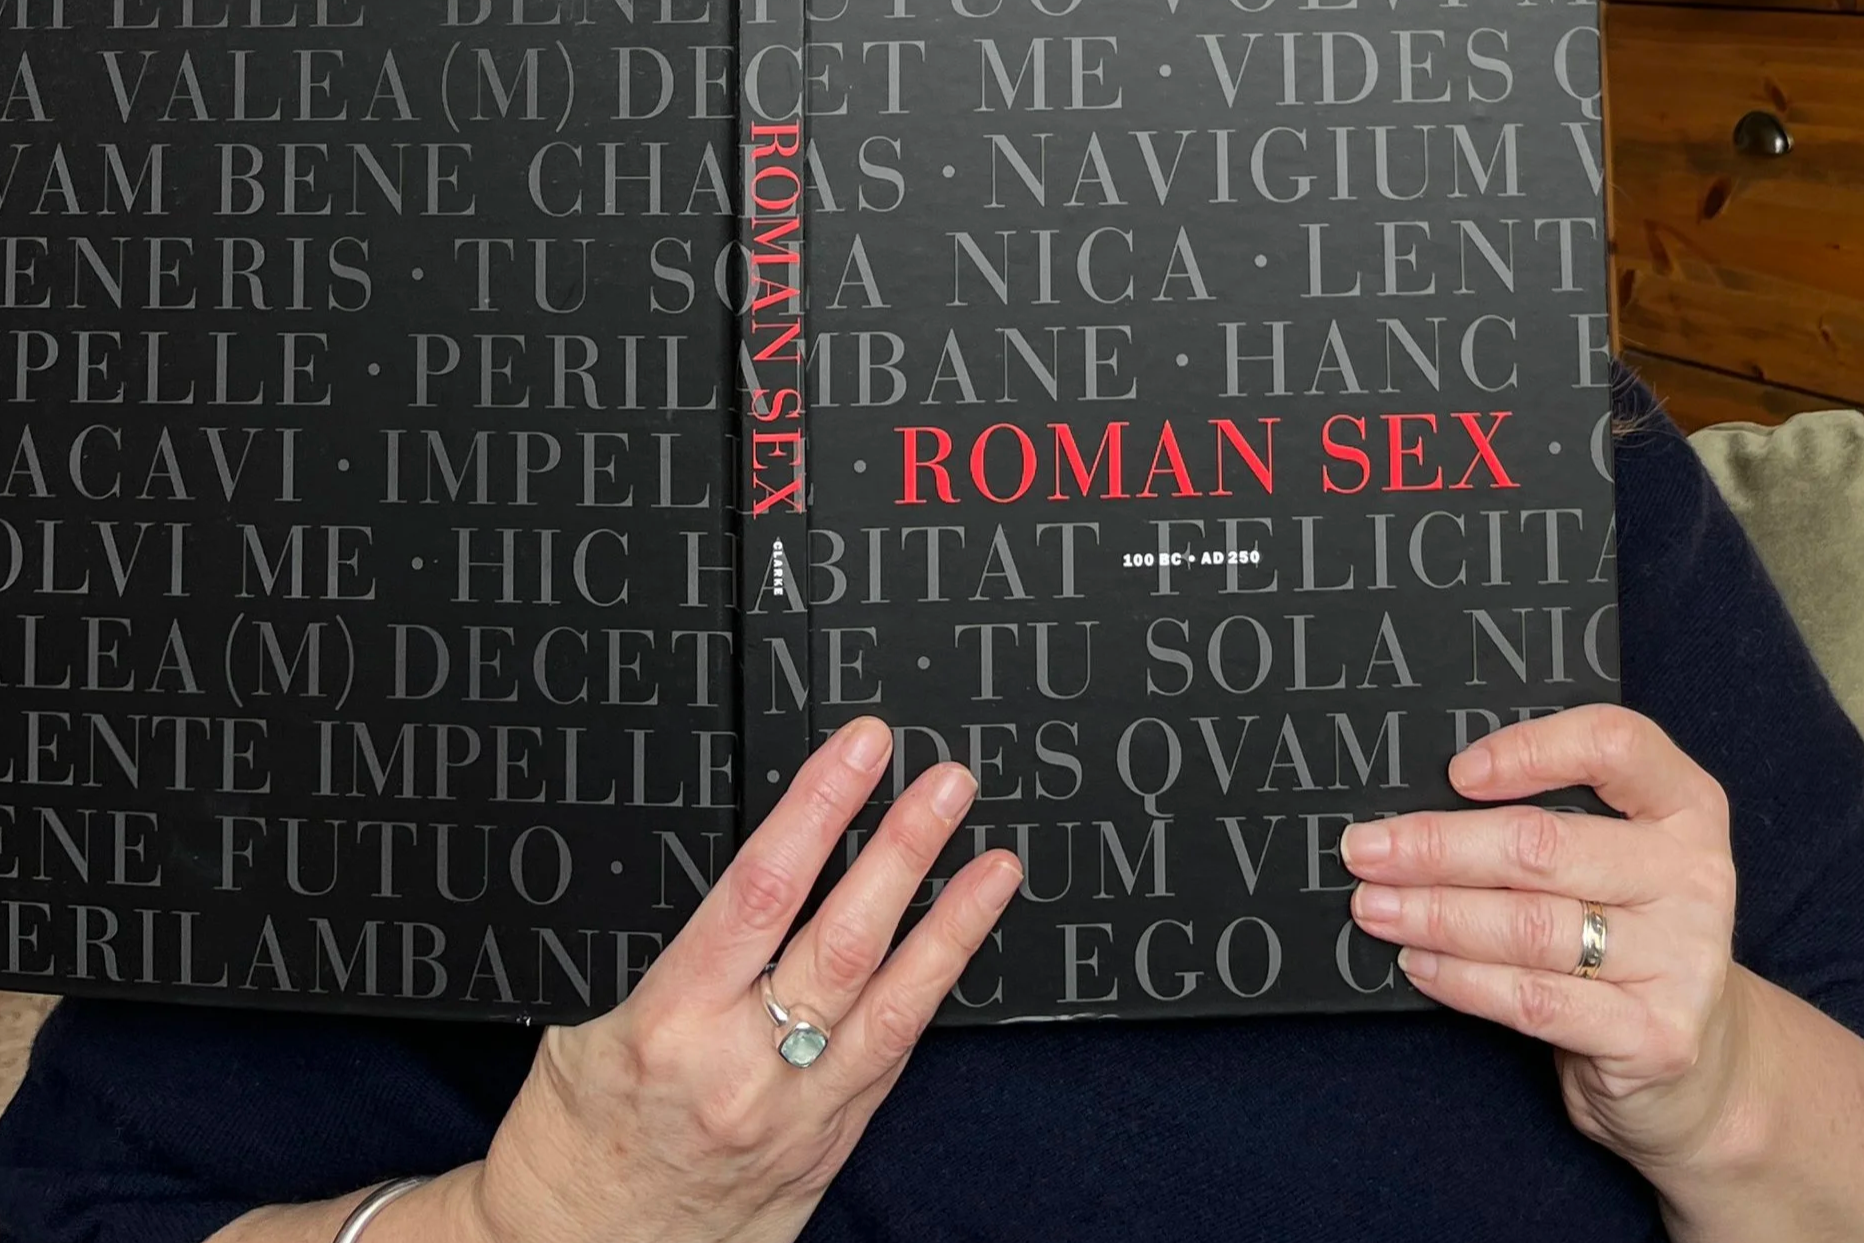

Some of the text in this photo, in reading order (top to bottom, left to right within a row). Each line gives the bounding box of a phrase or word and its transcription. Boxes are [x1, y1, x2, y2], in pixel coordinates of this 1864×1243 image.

[611, 40, 925, 121] DECET
[973, 35, 1123, 115] ME
[1196, 28, 1514, 108] VIDES
[214, 142, 476, 217] BENE
[983, 123, 1527, 209] NAVIGIUM
[0, 236, 373, 312] ENERIS
[455, 238, 596, 313] TU
[946, 226, 1216, 307] NICA
[1301, 217, 1597, 299] LENT
[7, 331, 332, 407] PELLE
[1217, 314, 1519, 398] HANC
[751, 120, 802, 597] ROMAN SEX CLARKE
[0, 424, 303, 503] ACAVI
[894, 417, 1283, 506] ROMAN
[1321, 410, 1521, 495] SEX
[236, 524, 377, 600] ME
[450, 527, 630, 608] HIC
[1122, 550, 1260, 567] 100 BC AD 250
[386, 623, 734, 709] DECET
[953, 620, 1101, 703] TU
[1144, 610, 1421, 700] SOLA
[313, 720, 739, 809] IMPELLE
[1114, 709, 1411, 817] QVAM
[213, 816, 573, 906] FUTUO
[1054, 916, 1282, 1004] EGO
